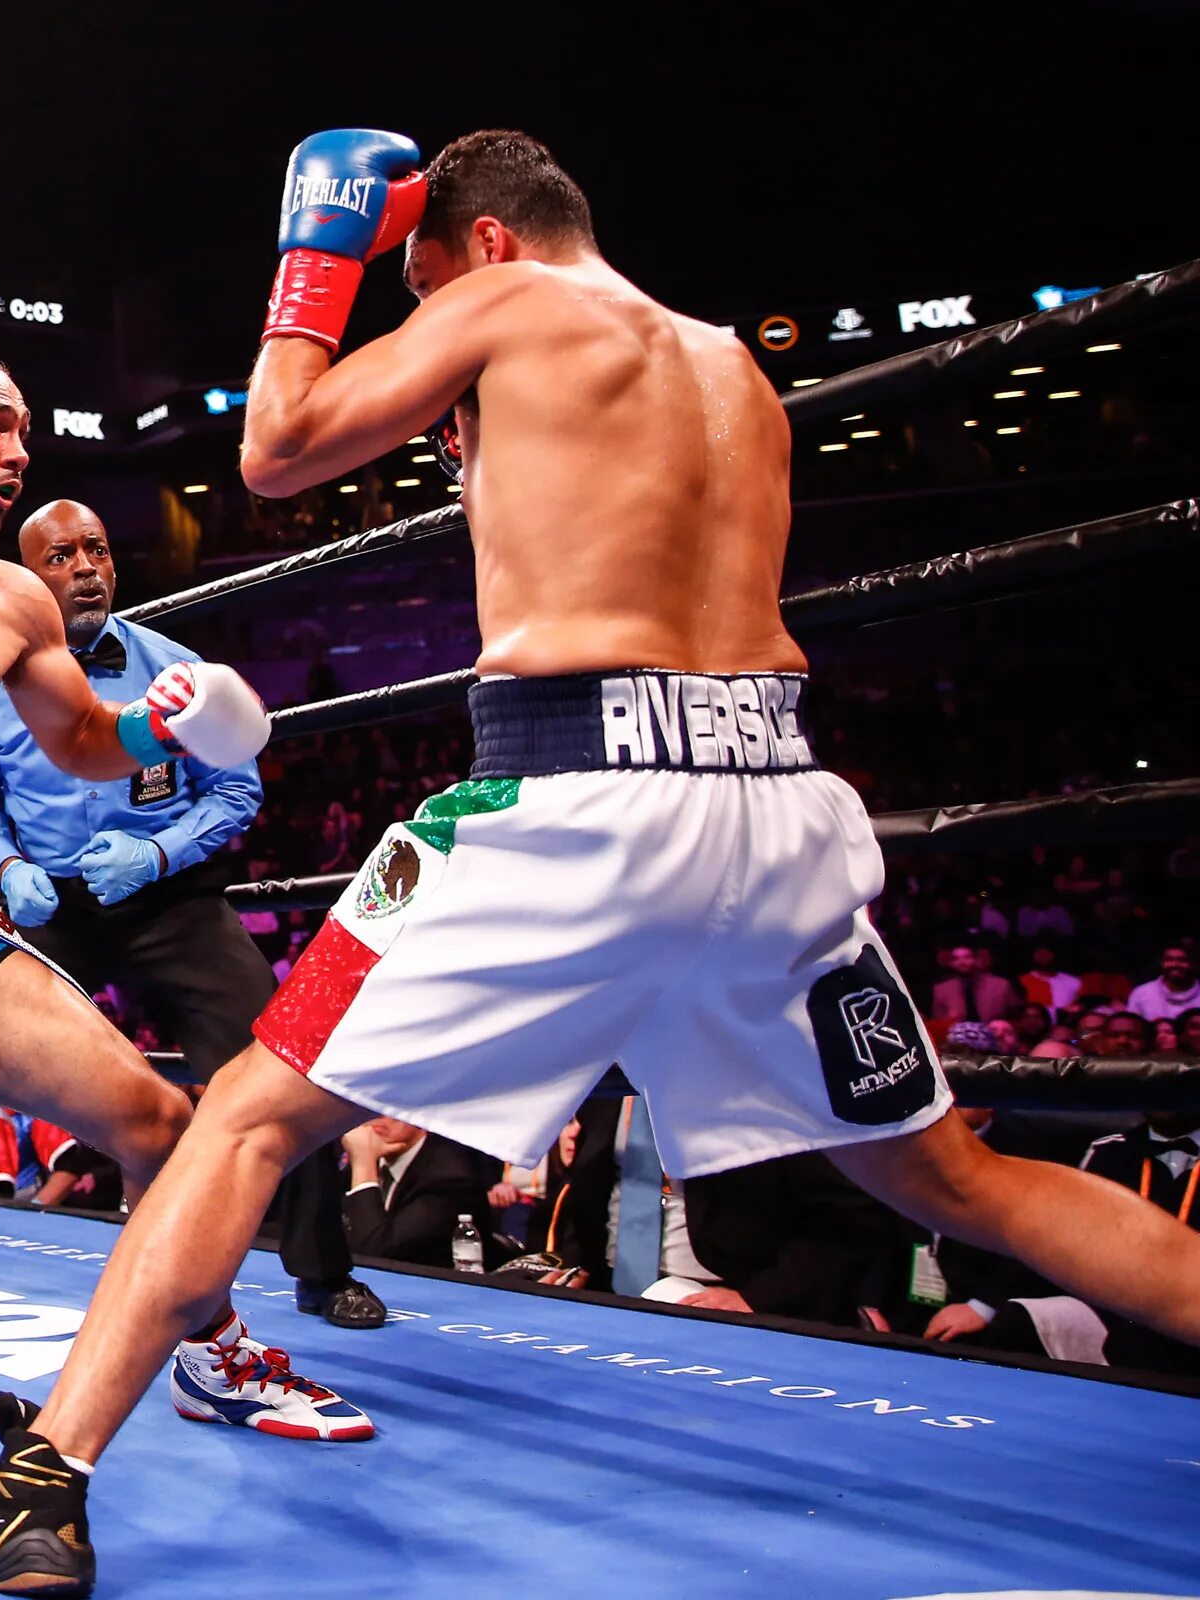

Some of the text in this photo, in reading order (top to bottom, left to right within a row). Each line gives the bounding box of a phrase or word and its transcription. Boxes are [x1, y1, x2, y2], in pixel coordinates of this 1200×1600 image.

[290, 174, 375, 219] EVERLAST
[9, 298, 63, 325] 0:03
[898, 295, 976, 333] FOX
[53, 408, 105, 440] FOX
[601, 676, 813, 768] RIVERSIDE
[437, 1323, 996, 1429] CHAMPIONS
